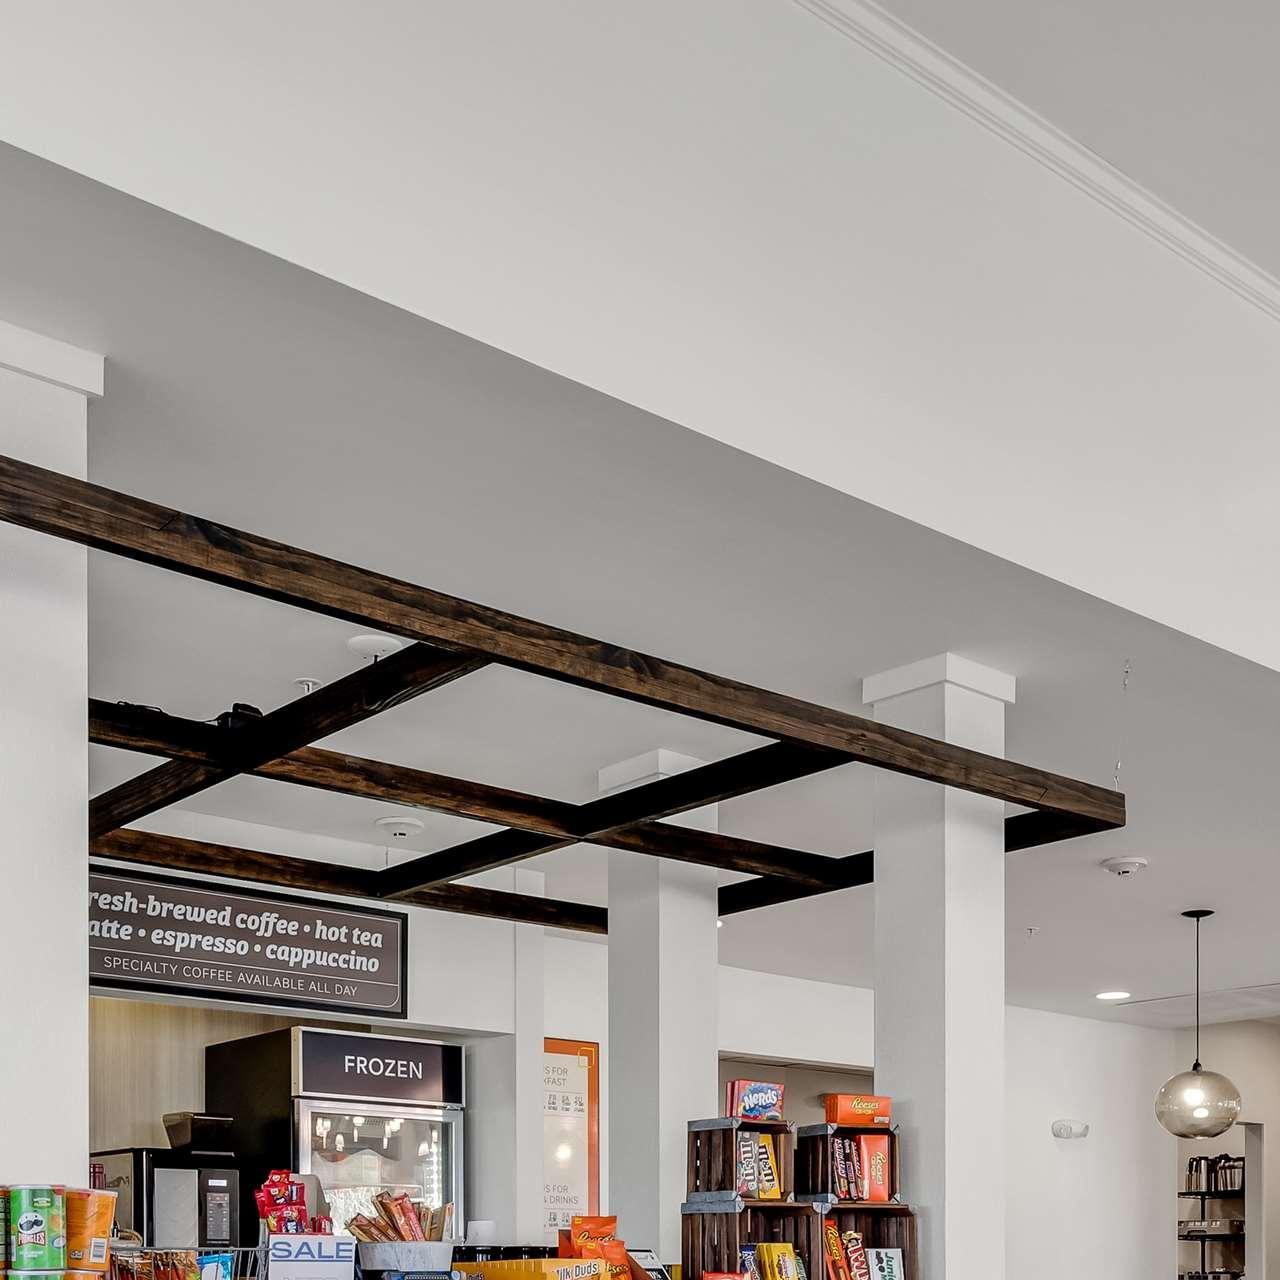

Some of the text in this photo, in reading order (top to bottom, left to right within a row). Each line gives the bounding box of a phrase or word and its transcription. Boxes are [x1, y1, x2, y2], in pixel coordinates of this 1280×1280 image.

[89, 891, 383, 948] resh-brewed coffee hot tea
[89, 919, 380, 973] atte espresso cappuccino
[103, 956, 358, 997] SPECIALTY COFFEE AVAILABLE ALL DAY
[344, 1055, 423, 1080] FROZEN
[271, 1241, 353, 1259] SALE
[574, 1261, 599, 1278] Duds
